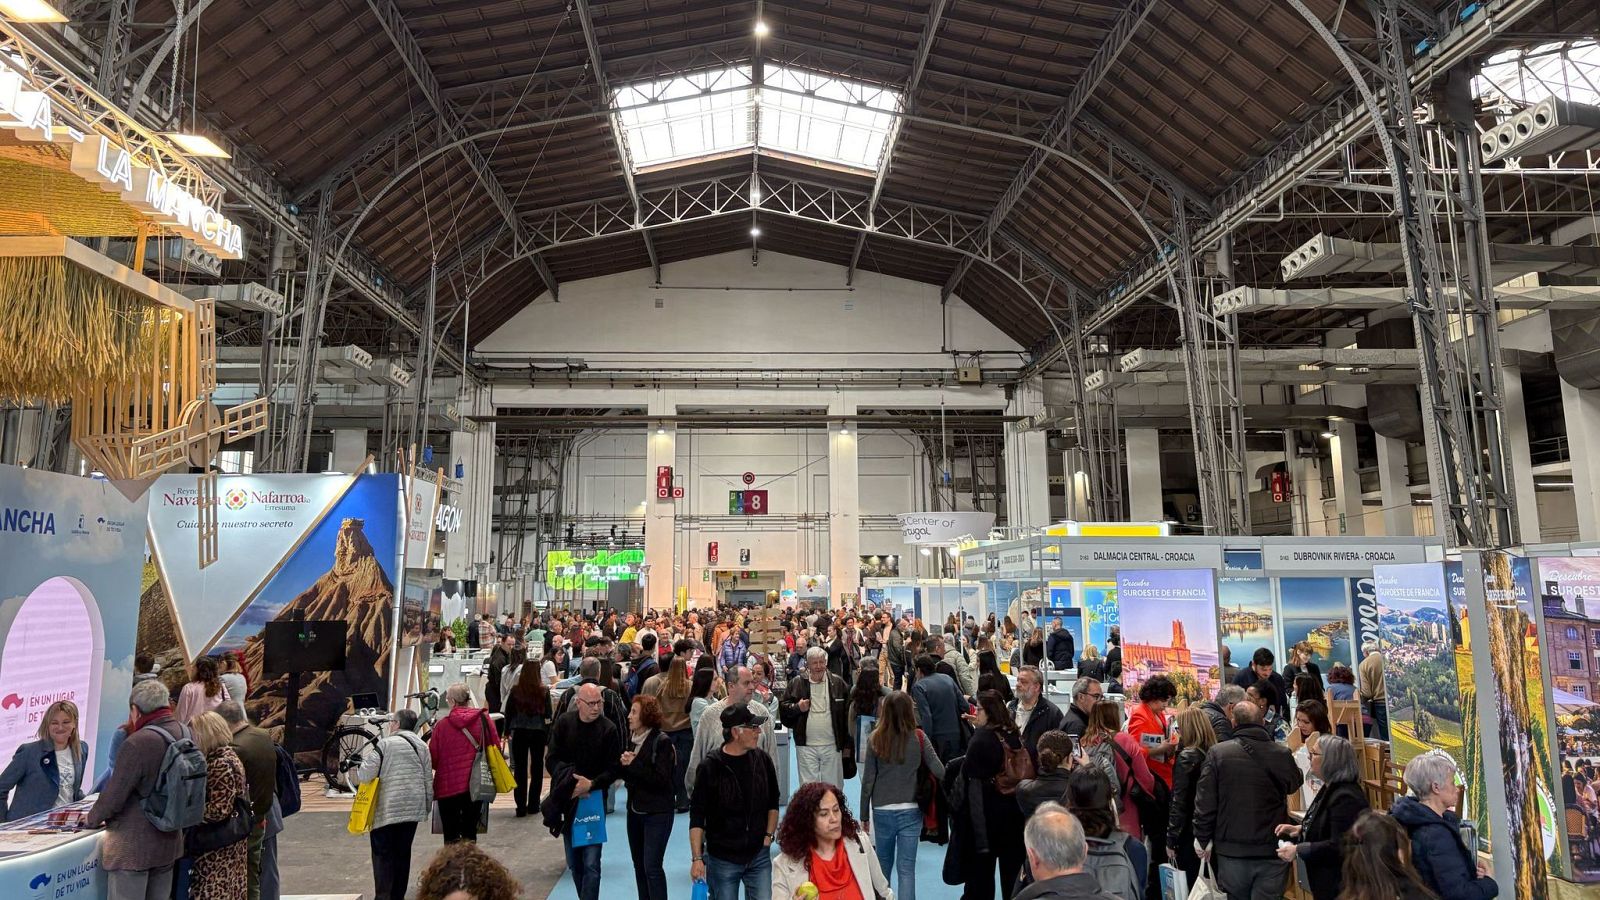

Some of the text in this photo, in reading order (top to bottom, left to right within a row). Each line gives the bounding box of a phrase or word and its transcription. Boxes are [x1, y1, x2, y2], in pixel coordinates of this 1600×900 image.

[98, 135, 132, 191] LA
[146, 168, 243, 258] MANCHA
[264, 504, 296, 512] Erresuma
[751, 495, 761, 510] 8
[0, 508, 55, 535] NCHA
[435, 500, 463, 533] AGÓN
[906, 516, 940, 526] Center
[941, 519, 956, 528] of
[221, 521, 258, 529] nuestro
[259, 520, 294, 529] secreto
[1093, 551, 1128, 561] DALMACIA
[1129, 552, 1160, 561] CENTRAL
[1164, 552, 1195, 561] CROACIA
[1293, 551, 1333, 561] DUBROVNIK
[1333, 551, 1360, 561] RIVIERA
[1364, 551, 1396, 561] CROACIA
[1451, 572, 1465, 583] Desc
[1549, 569, 1593, 581] Descubre
[1123, 588, 1207, 597] SUROESTE DE FRANCIA
[1380, 587, 1440, 597] SUROESTE DE FRANCIA
[1453, 587, 1466, 596] SUR
[1550, 585, 1600, 596] SUROEST
[1096, 602, 1119, 613] Punt
[29, 696, 40, 707] EN
[41, 694, 51, 706] UN
[28, 711, 39, 723] DE
[57, 858, 99, 883] EN UN LUGAR
[55, 877, 90, 898] DE TU VIDA
